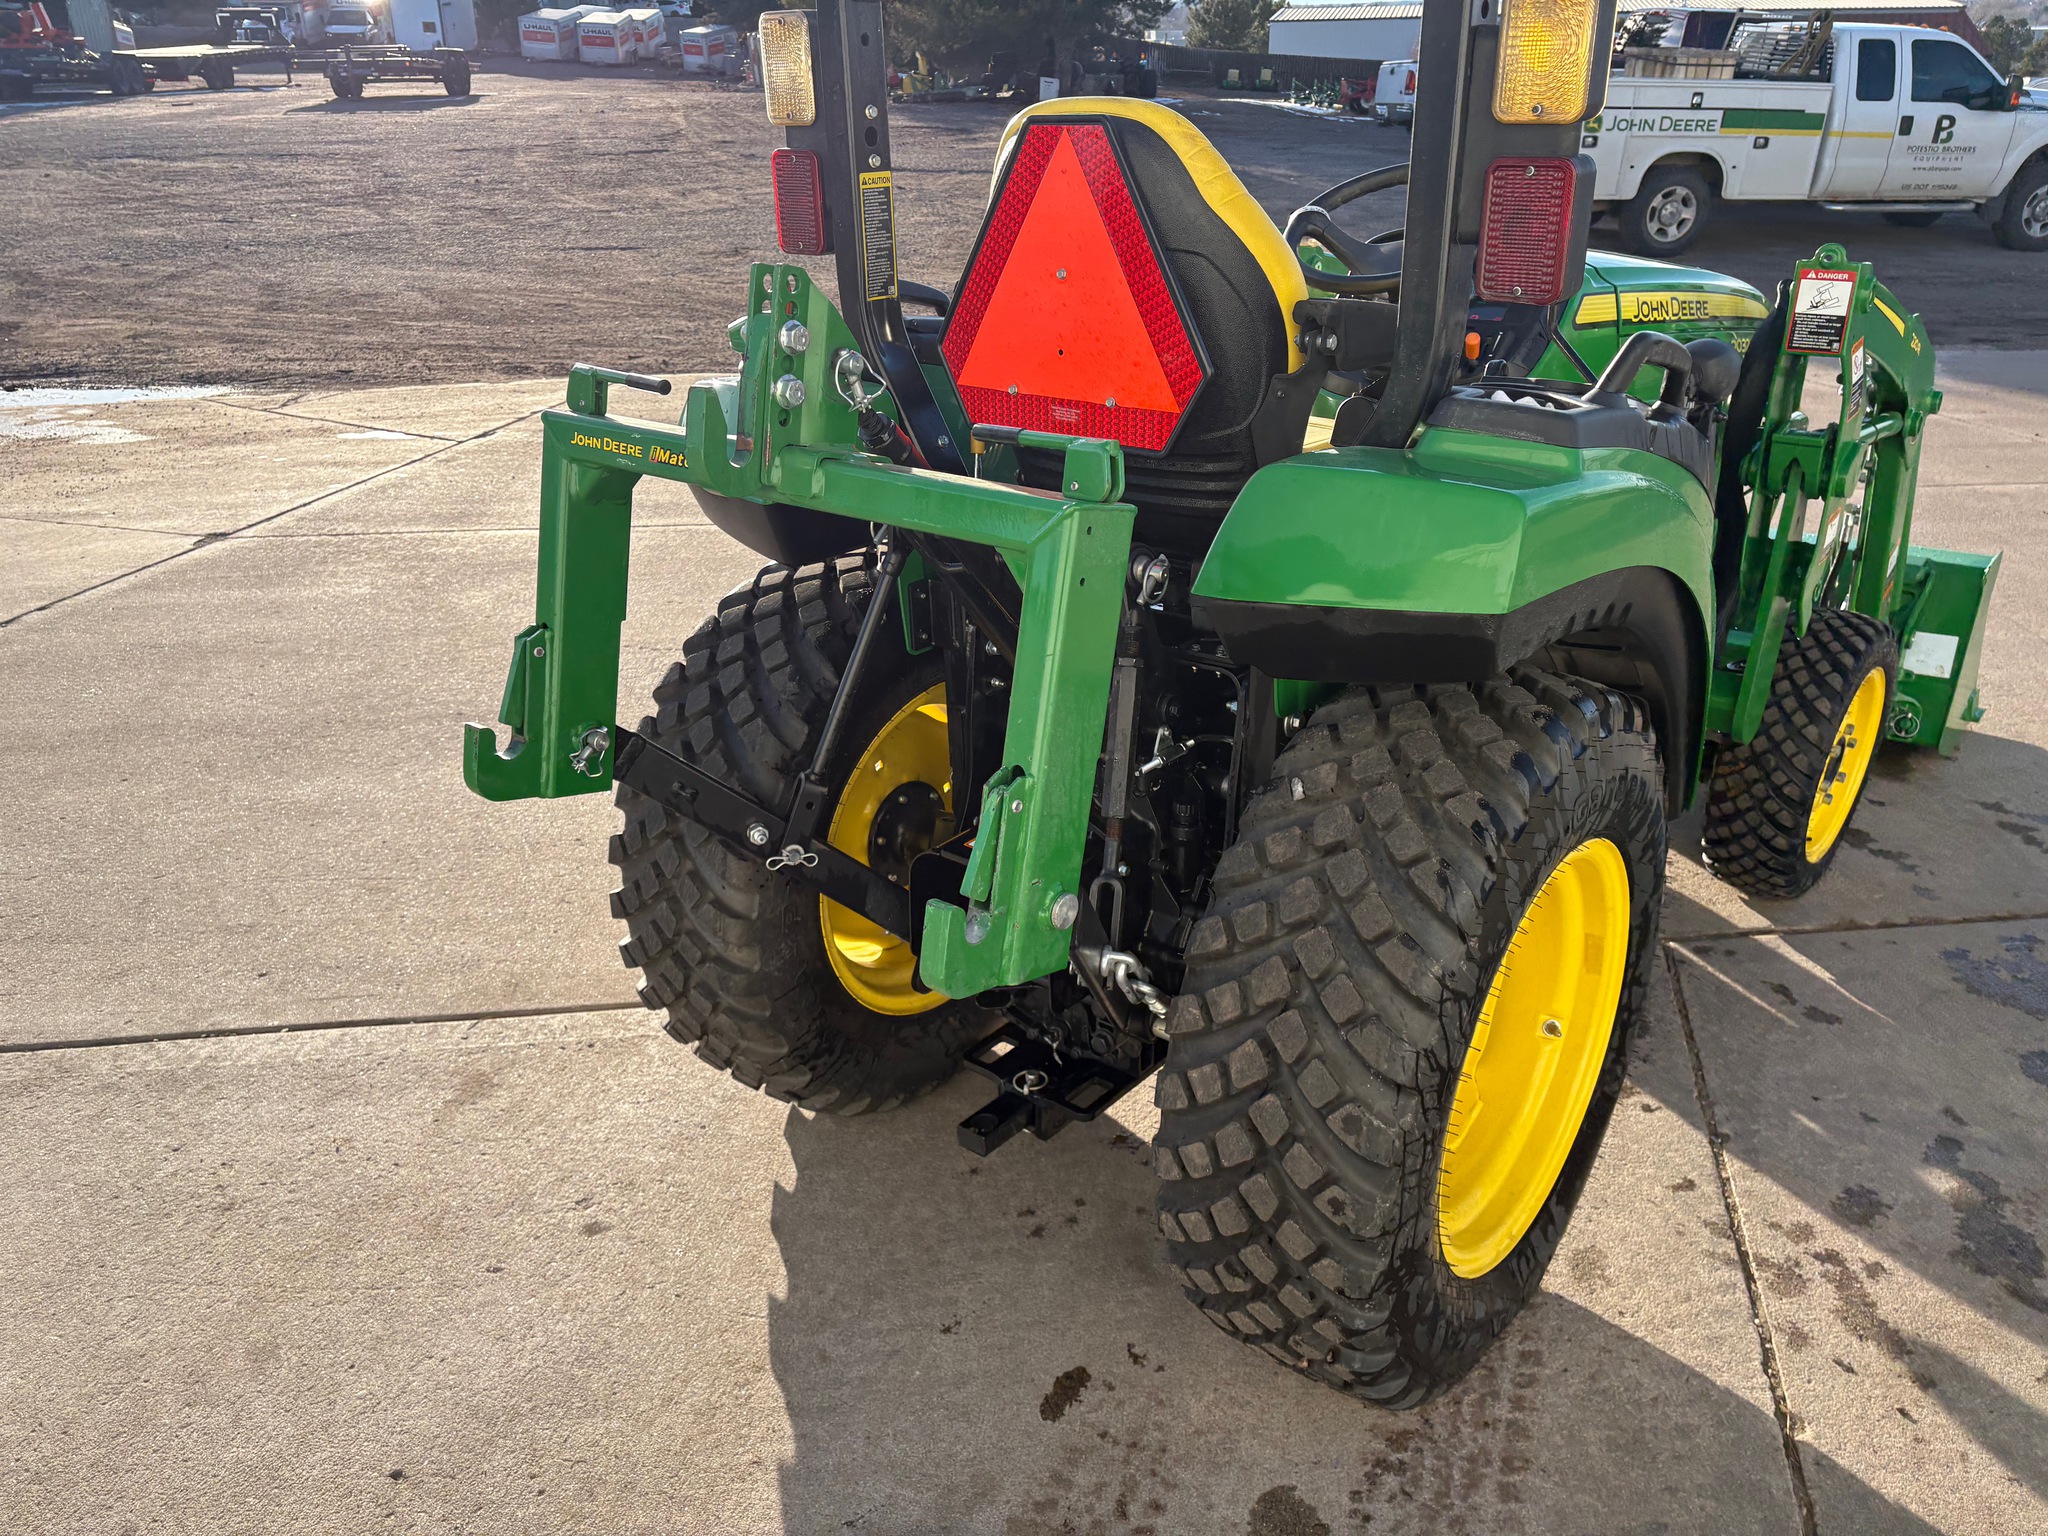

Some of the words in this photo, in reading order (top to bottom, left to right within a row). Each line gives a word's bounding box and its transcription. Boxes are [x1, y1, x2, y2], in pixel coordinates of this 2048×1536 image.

[523, 23, 553, 32] U-HAUL
[582, 28, 613, 36] U-HAUL
[1605, 115, 1655, 132] JOHN
[1659, 115, 1718, 132] DEERE
[868, 177, 890, 185] CAUTION
[1817, 272, 1849, 280] DANGER
[1633, 297, 1669, 318] JOHN
[1670, 296, 1710, 317] DEERE
[570, 431, 601, 450] JOHN
[603, 437, 643, 458] DEERE
